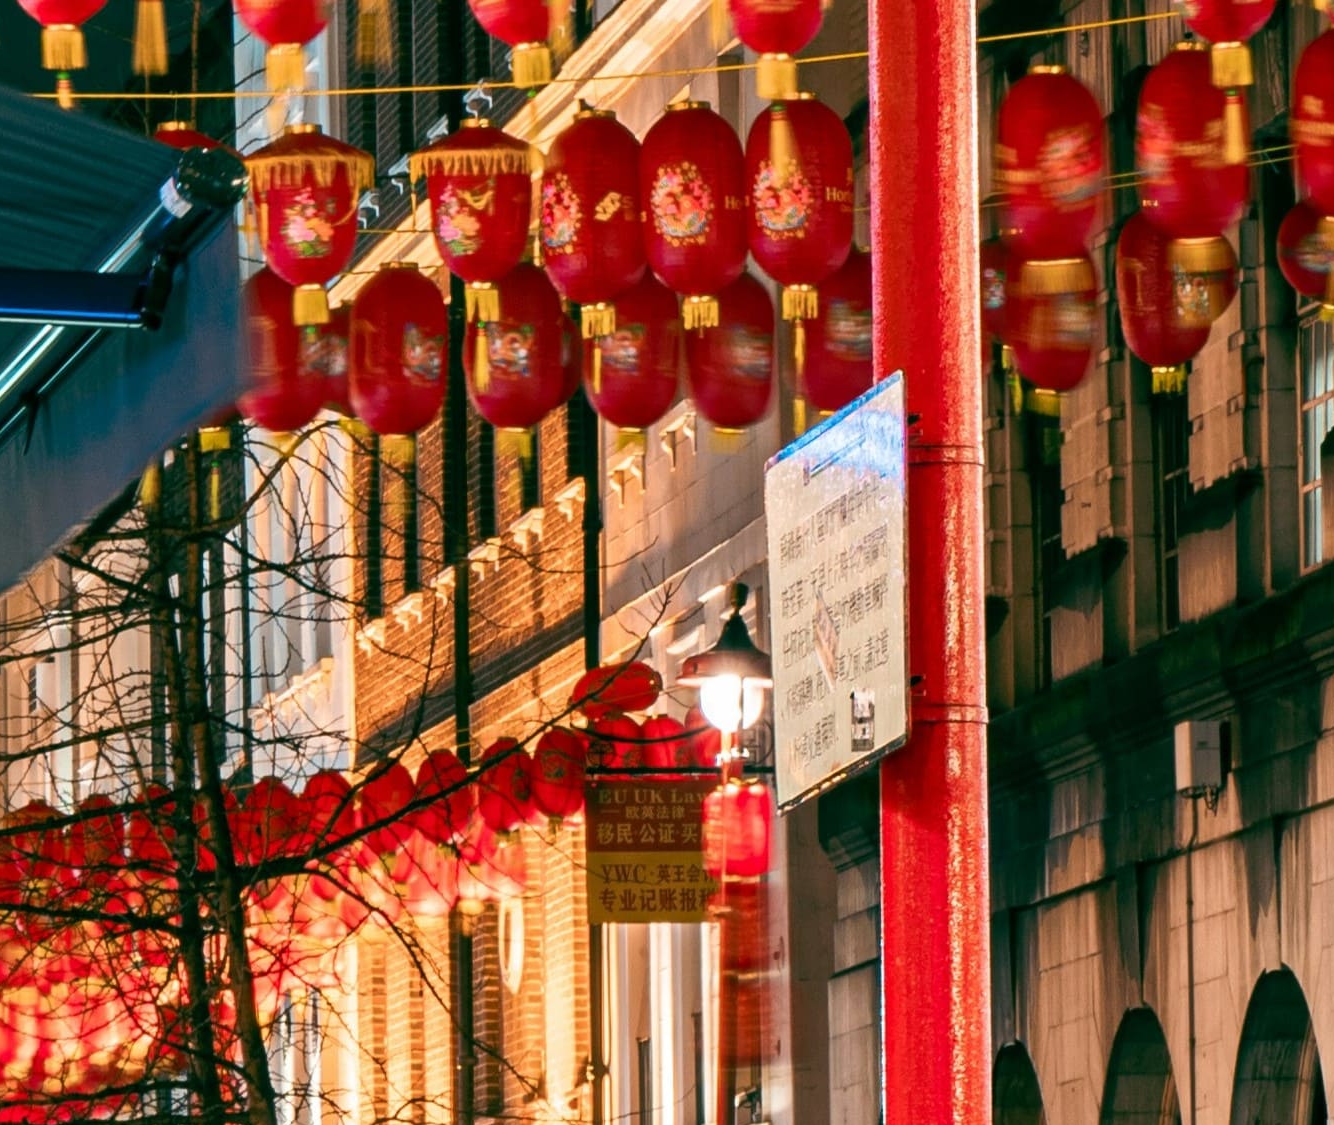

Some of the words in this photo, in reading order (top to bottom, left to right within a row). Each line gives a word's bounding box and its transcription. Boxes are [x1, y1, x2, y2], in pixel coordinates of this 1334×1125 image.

[599, 789, 628, 804] EU
[634, 788, 664, 803] UK
[602, 864, 646, 884] YWC
